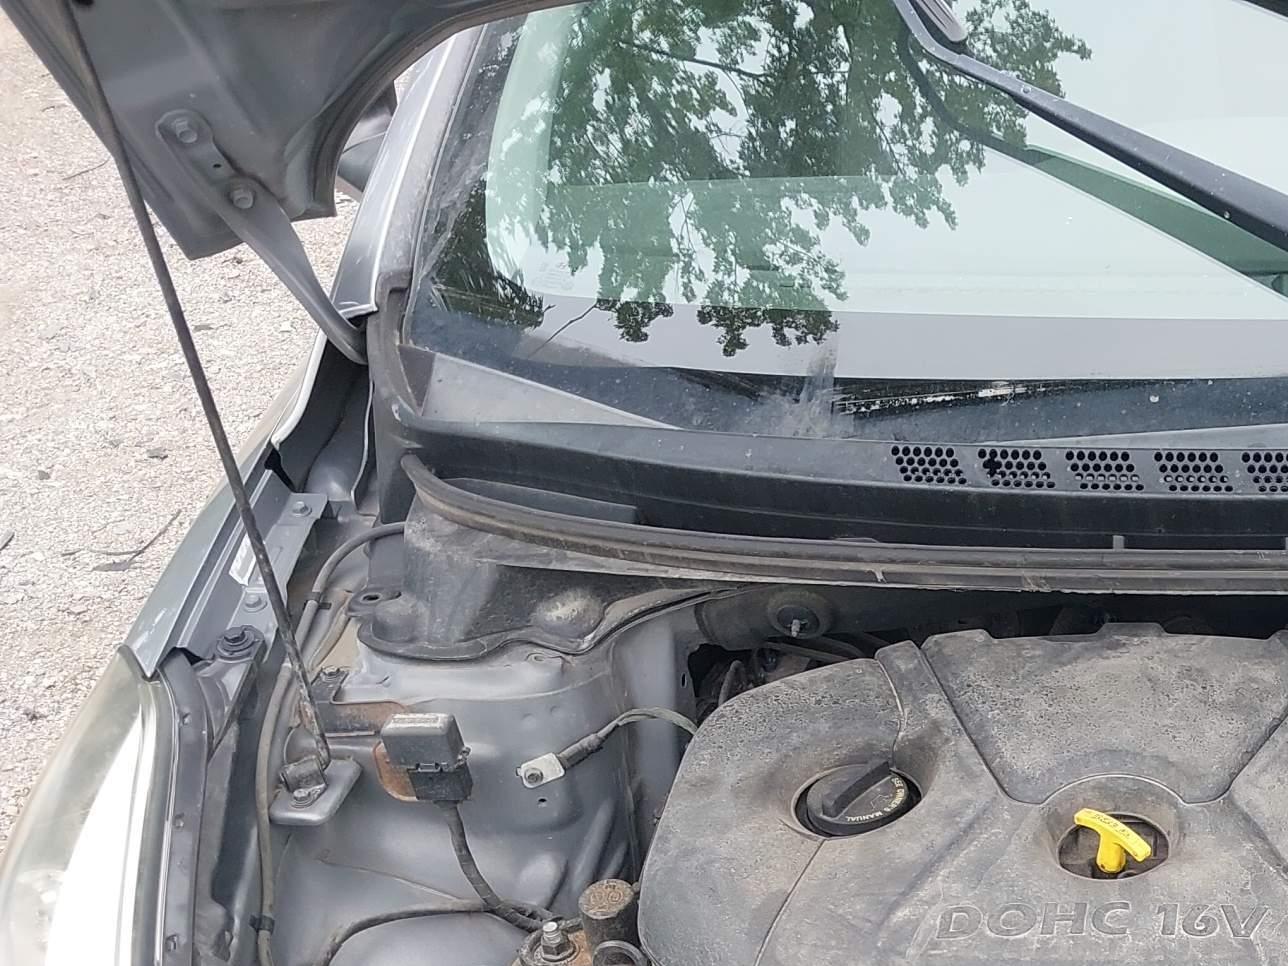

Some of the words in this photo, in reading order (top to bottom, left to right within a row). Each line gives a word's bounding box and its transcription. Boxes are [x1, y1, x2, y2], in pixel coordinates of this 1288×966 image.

[846, 811, 884, 822] MANUAL
[935, 901, 1132, 939] DOHC
[1156, 902, 1271, 939] 16V
